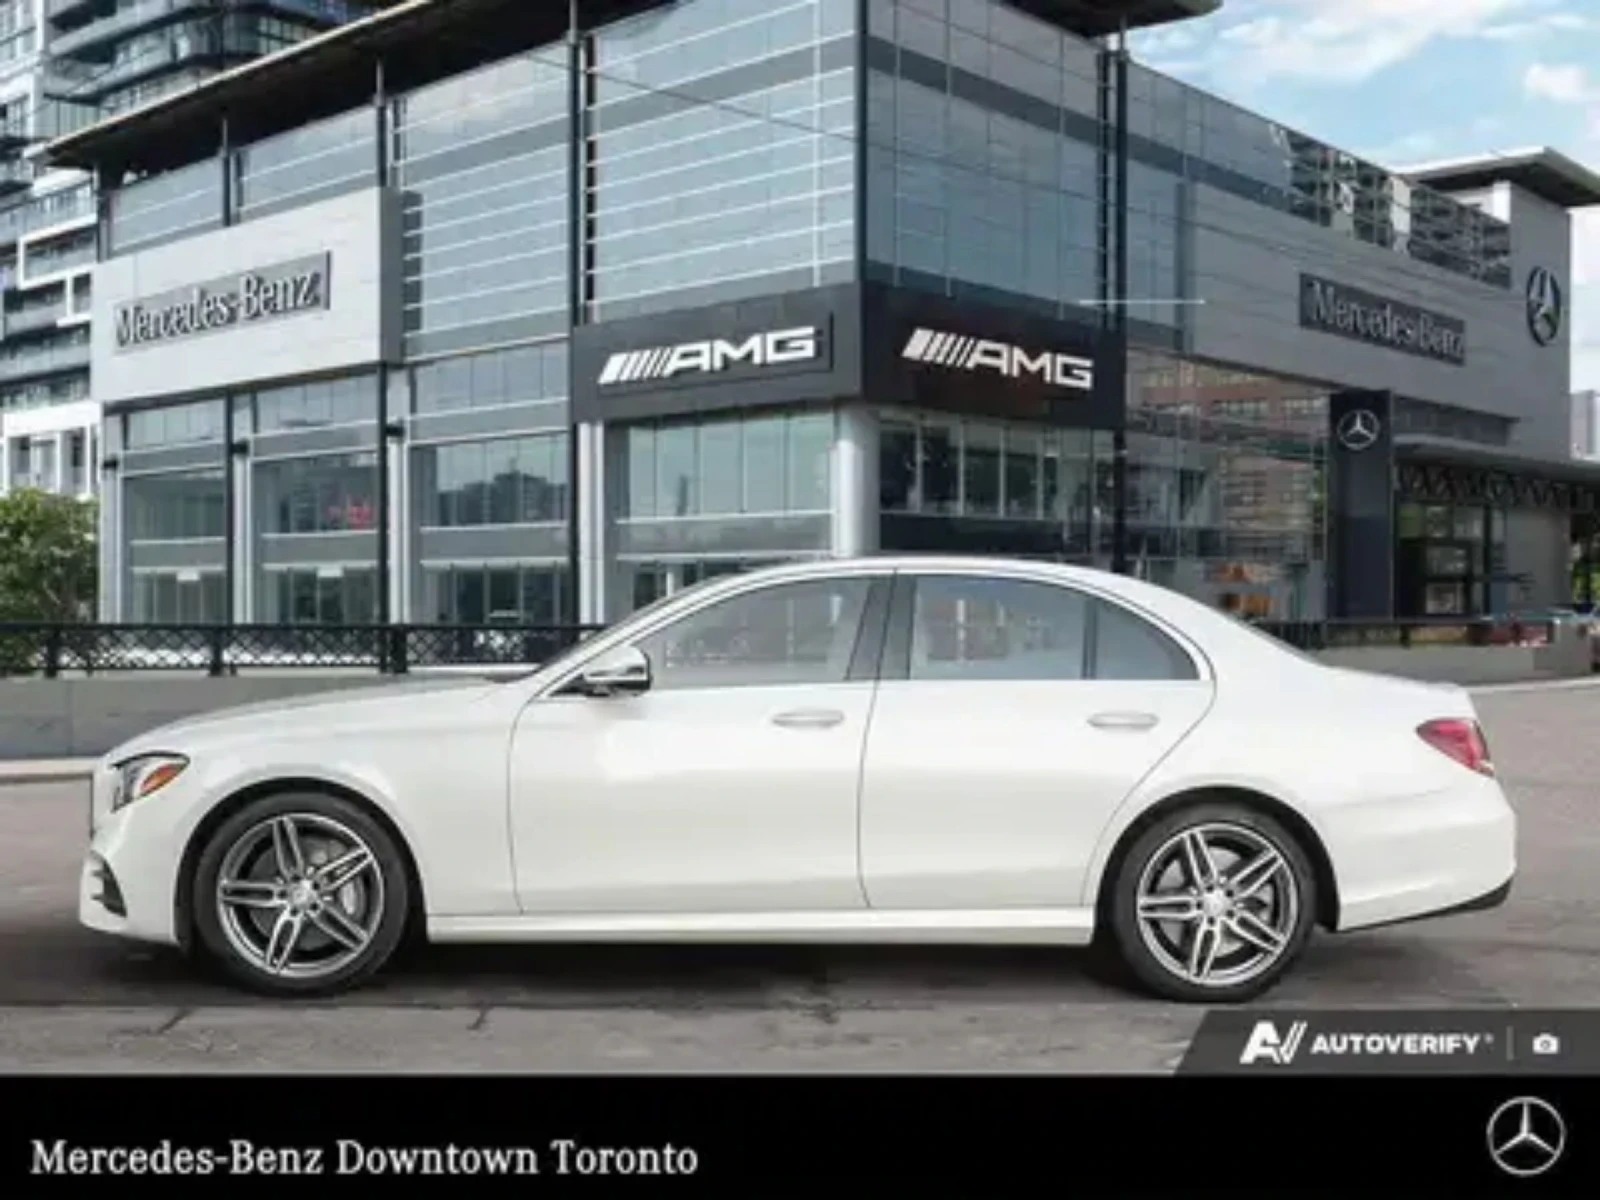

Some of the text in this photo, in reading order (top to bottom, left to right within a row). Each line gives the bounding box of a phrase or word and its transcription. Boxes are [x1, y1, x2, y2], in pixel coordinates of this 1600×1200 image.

[114, 269, 322, 347] Mercedes-Benz
[664, 326, 815, 377] AMG
[966, 339, 1094, 391] AMG
